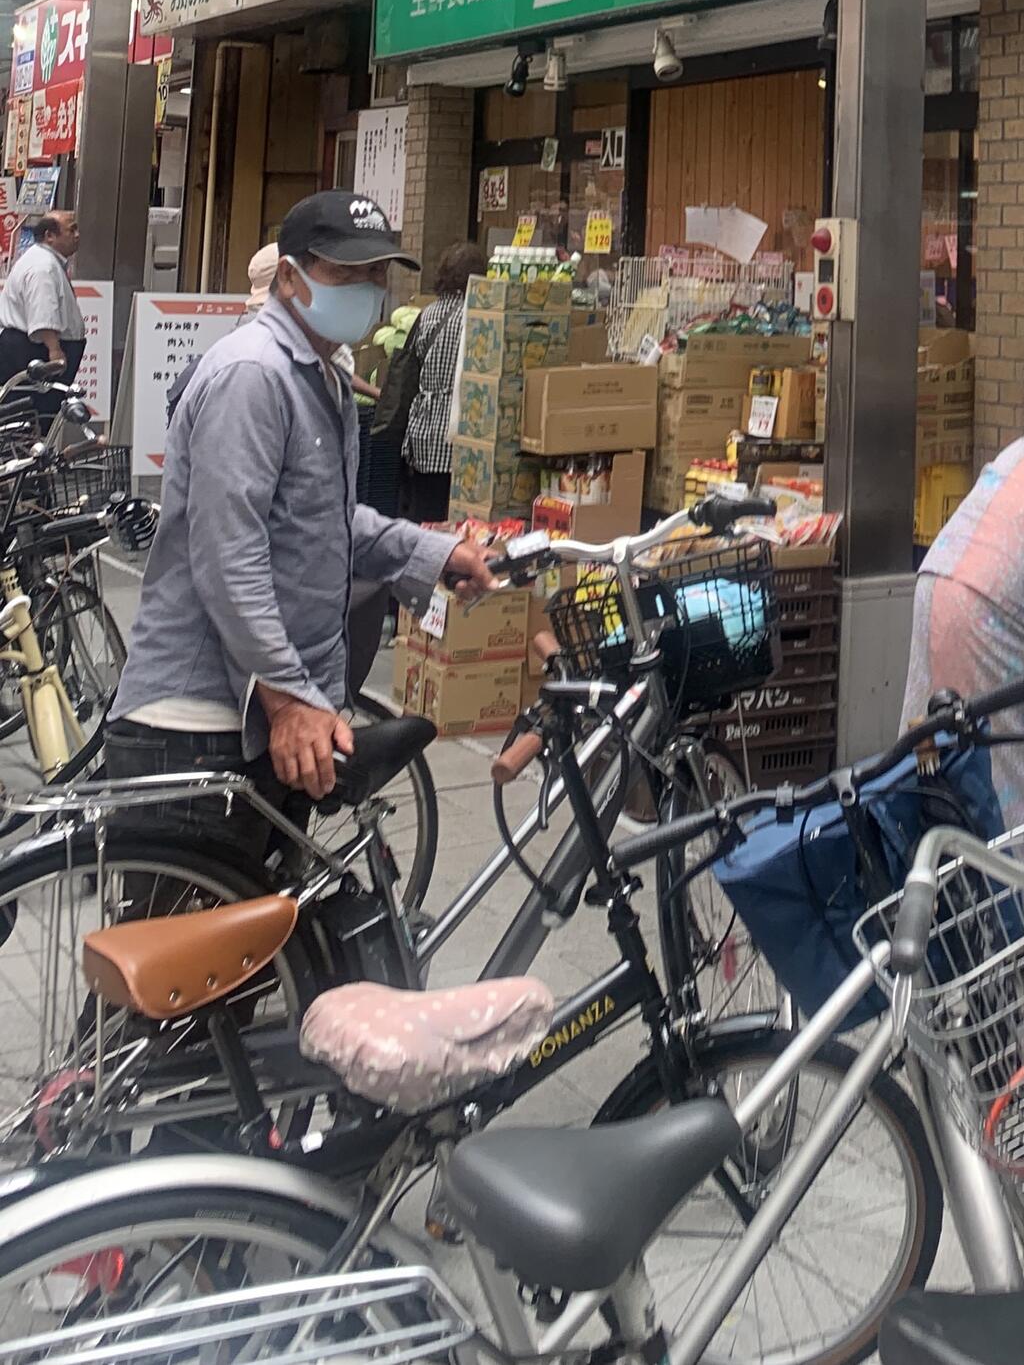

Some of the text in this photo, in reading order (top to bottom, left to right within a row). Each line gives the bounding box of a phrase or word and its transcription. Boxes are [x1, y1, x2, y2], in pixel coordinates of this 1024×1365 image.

[601, 128, 625, 169] 入口
[196, 303, 234, 314] メニュー
[155, 321, 200, 332] お好み焼き
[167, 337, 194, 348] 肉入り
[529, 994, 616, 1068] BONANZA
